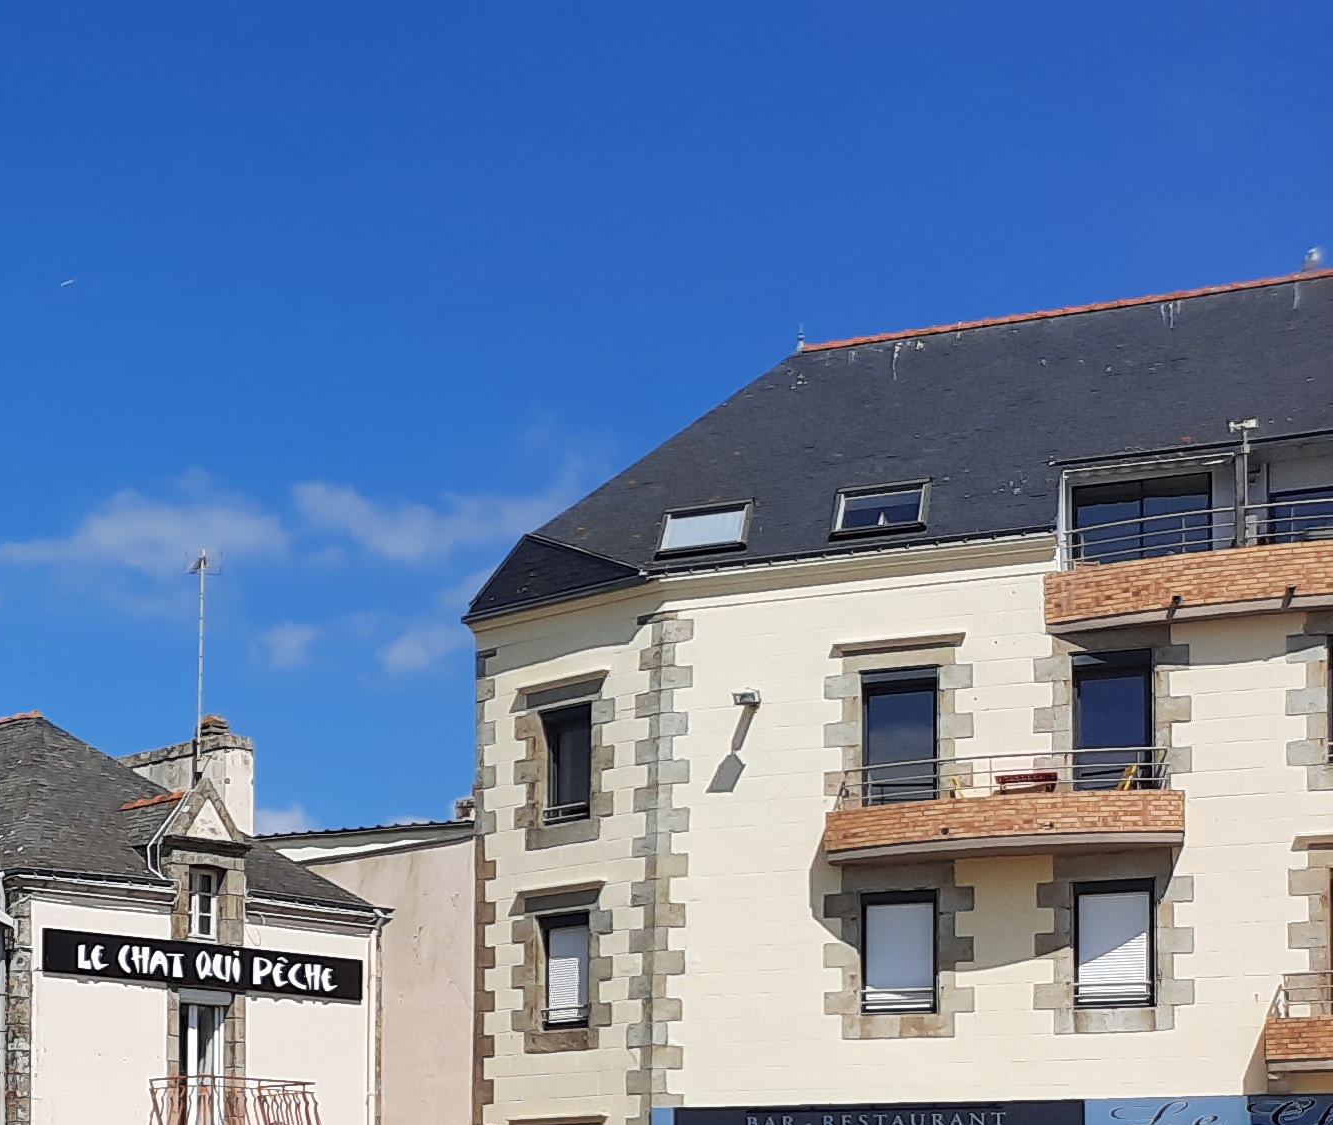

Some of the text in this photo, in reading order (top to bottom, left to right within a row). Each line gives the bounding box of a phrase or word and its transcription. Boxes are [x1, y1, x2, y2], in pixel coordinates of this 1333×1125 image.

[76, 944, 338, 992] LE CHAT QUI PÊCHE
